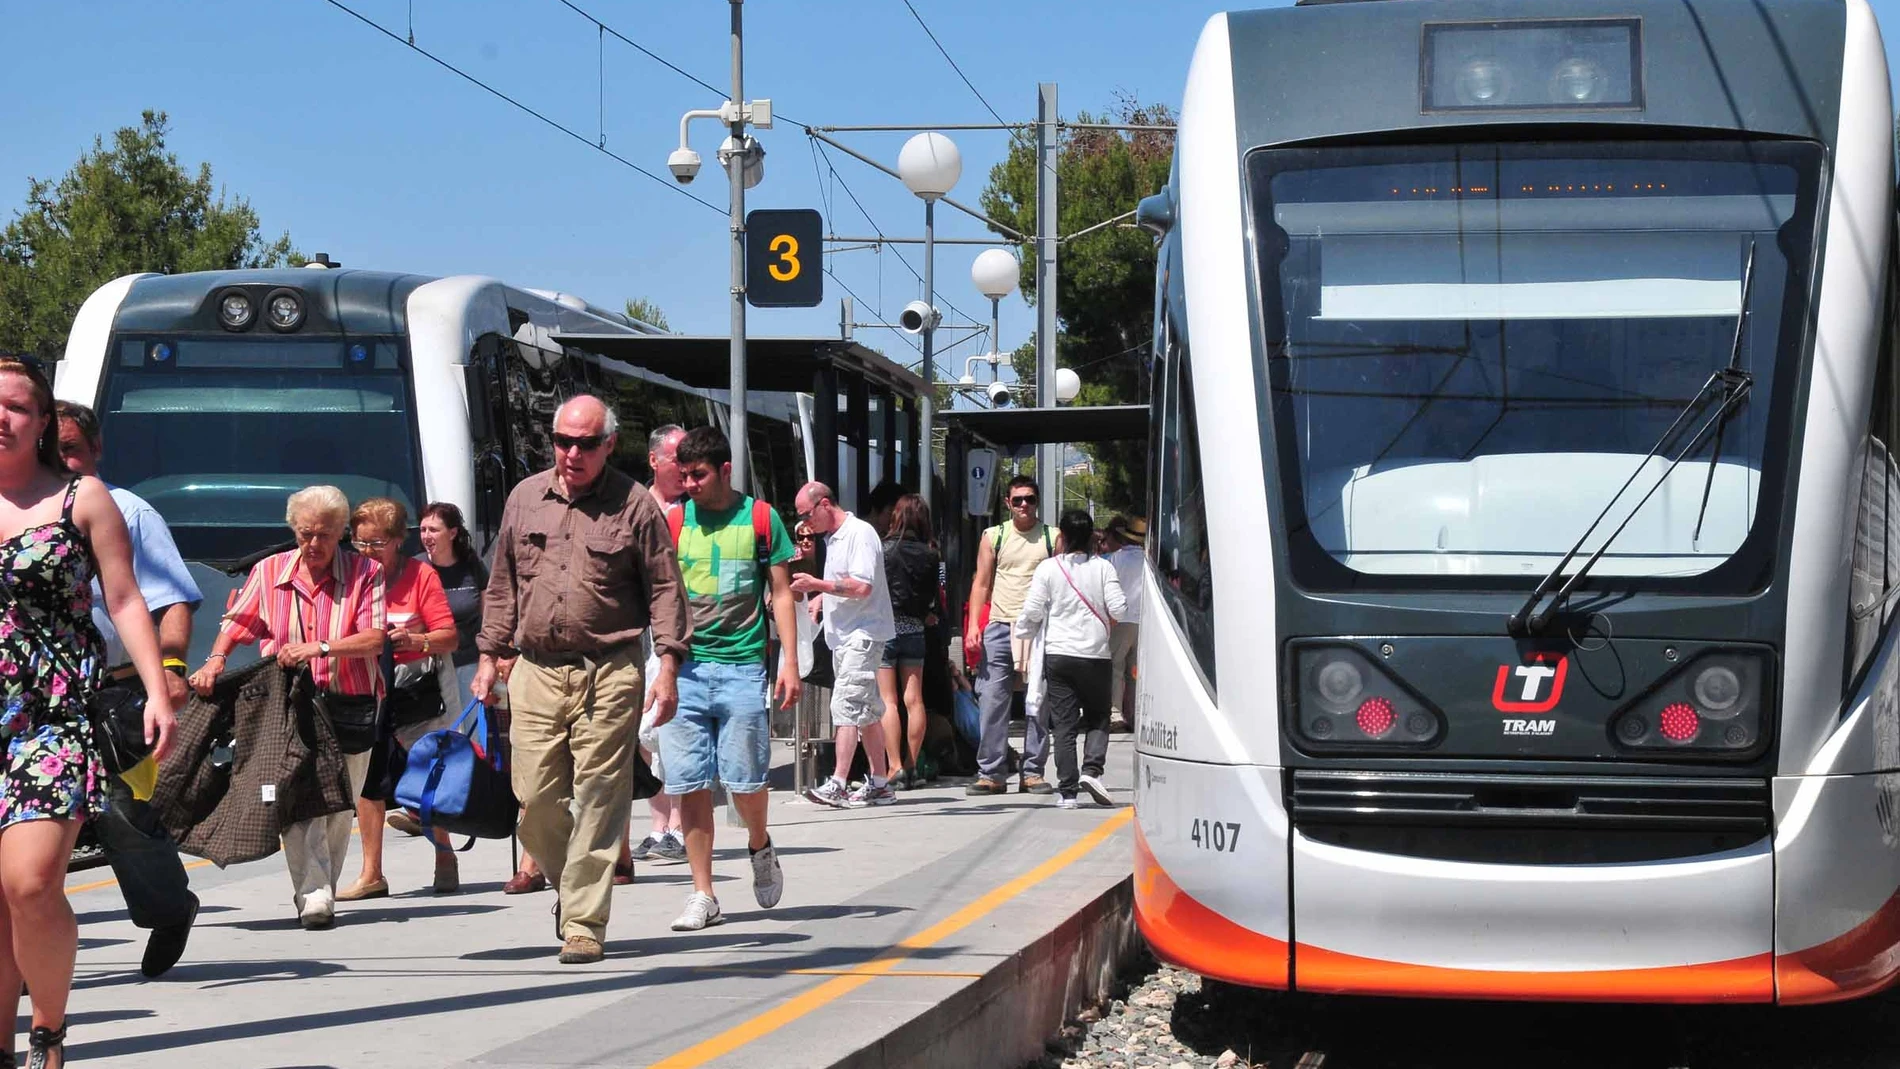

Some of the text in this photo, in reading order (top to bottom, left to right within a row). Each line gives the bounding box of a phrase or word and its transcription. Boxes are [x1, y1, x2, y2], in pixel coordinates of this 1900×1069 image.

[769, 234, 801, 281] 3
[1502, 719, 1556, 732] TRAM
[1191, 818, 1241, 853] 4107
